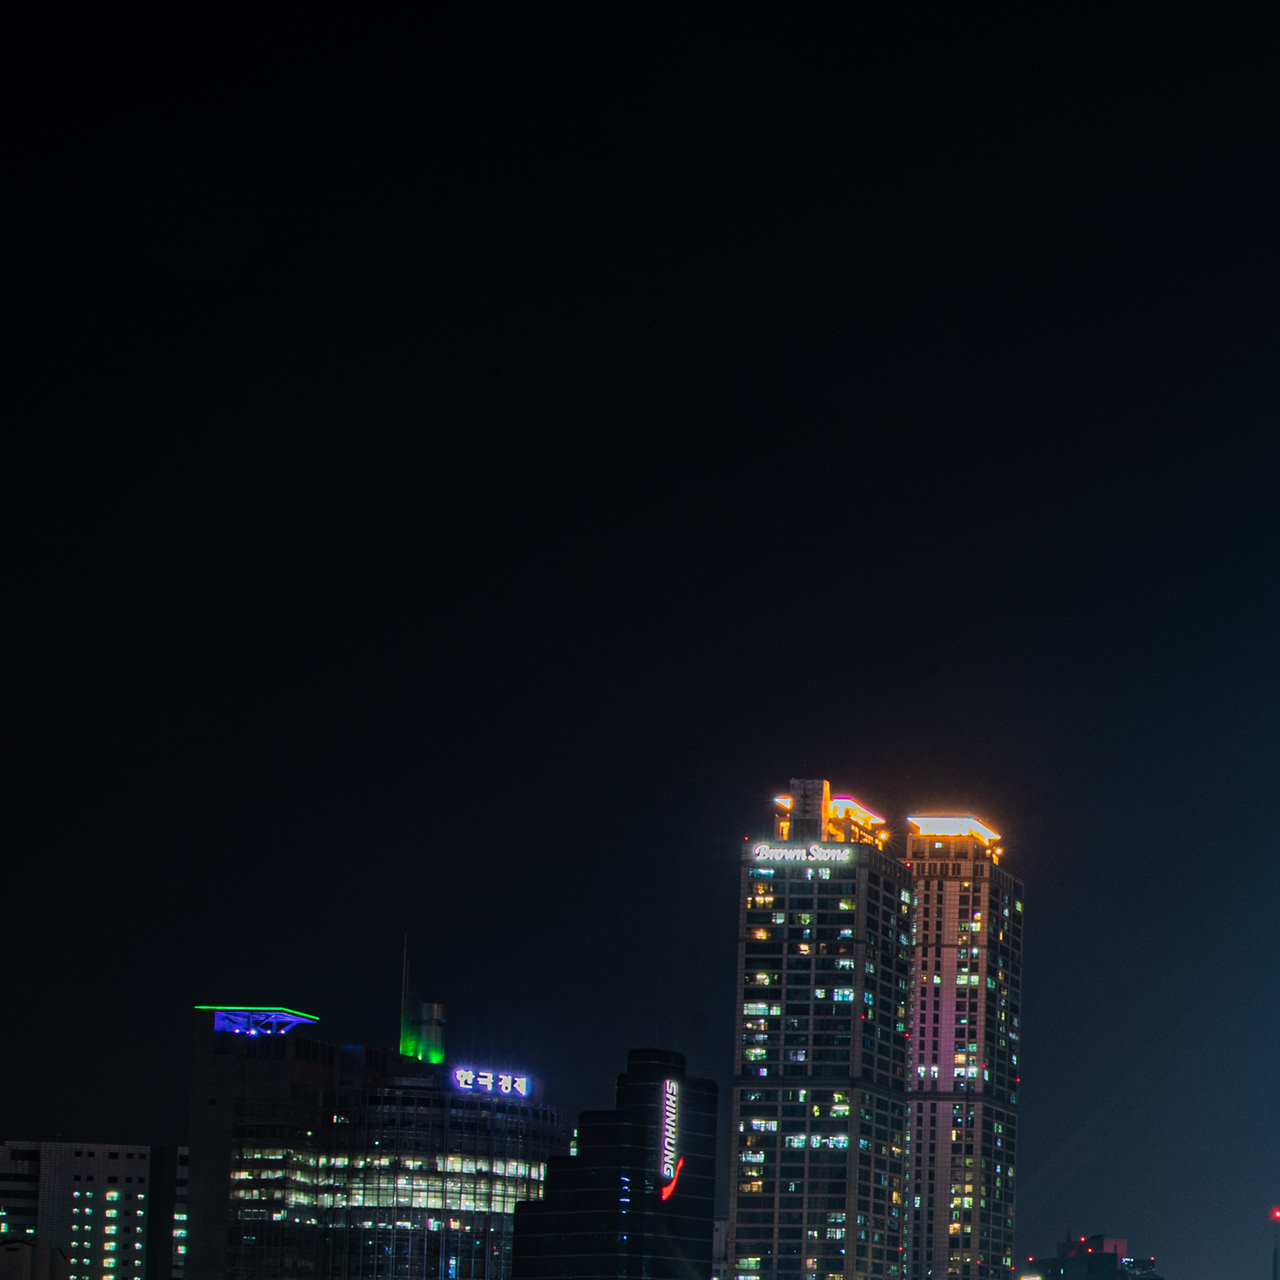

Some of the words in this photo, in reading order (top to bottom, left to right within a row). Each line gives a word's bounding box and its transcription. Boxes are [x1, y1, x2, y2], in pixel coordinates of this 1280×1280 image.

[753, 844, 807, 861] Brown
[807, 844, 851, 861] Stone
[455, 1068, 528, 1097] 한국경제
[661, 1079, 678, 1178] SHINHUNG
